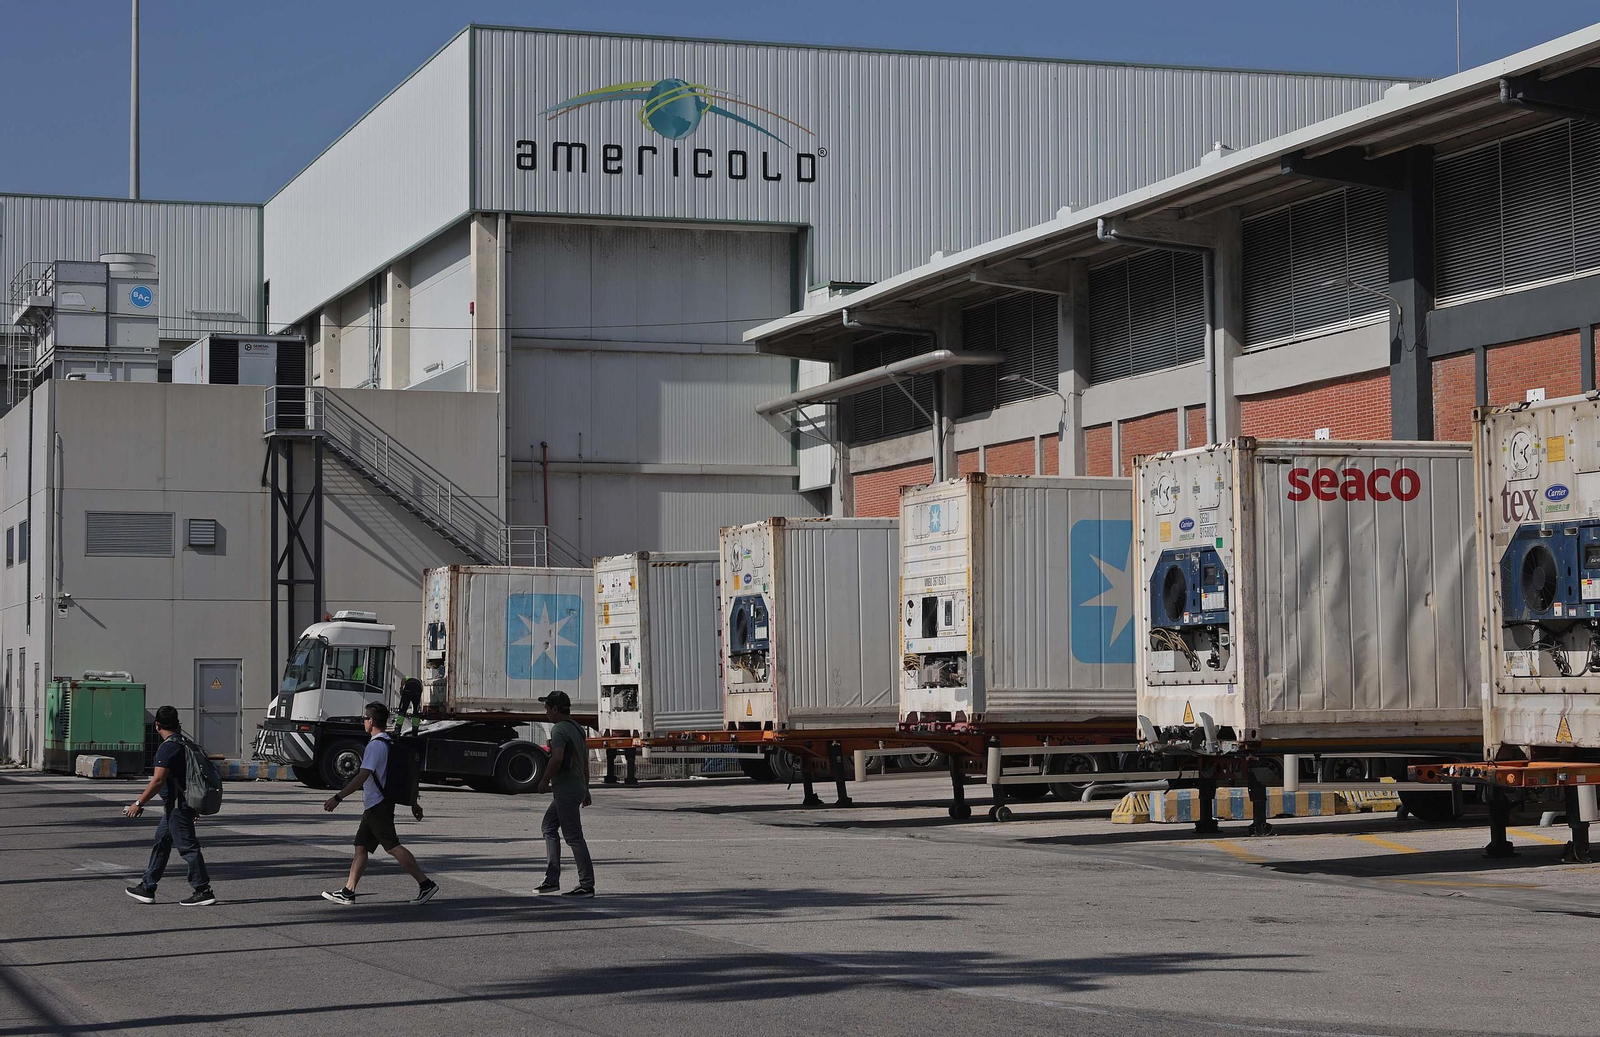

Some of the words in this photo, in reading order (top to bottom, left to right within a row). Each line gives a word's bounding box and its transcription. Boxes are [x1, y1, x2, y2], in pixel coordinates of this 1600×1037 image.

[133, 291, 150, 302] BAC
[1287, 468, 1421, 501] seaco
[1547, 488, 1567, 498] Carrier
[1501, 481, 1540, 523] tex
